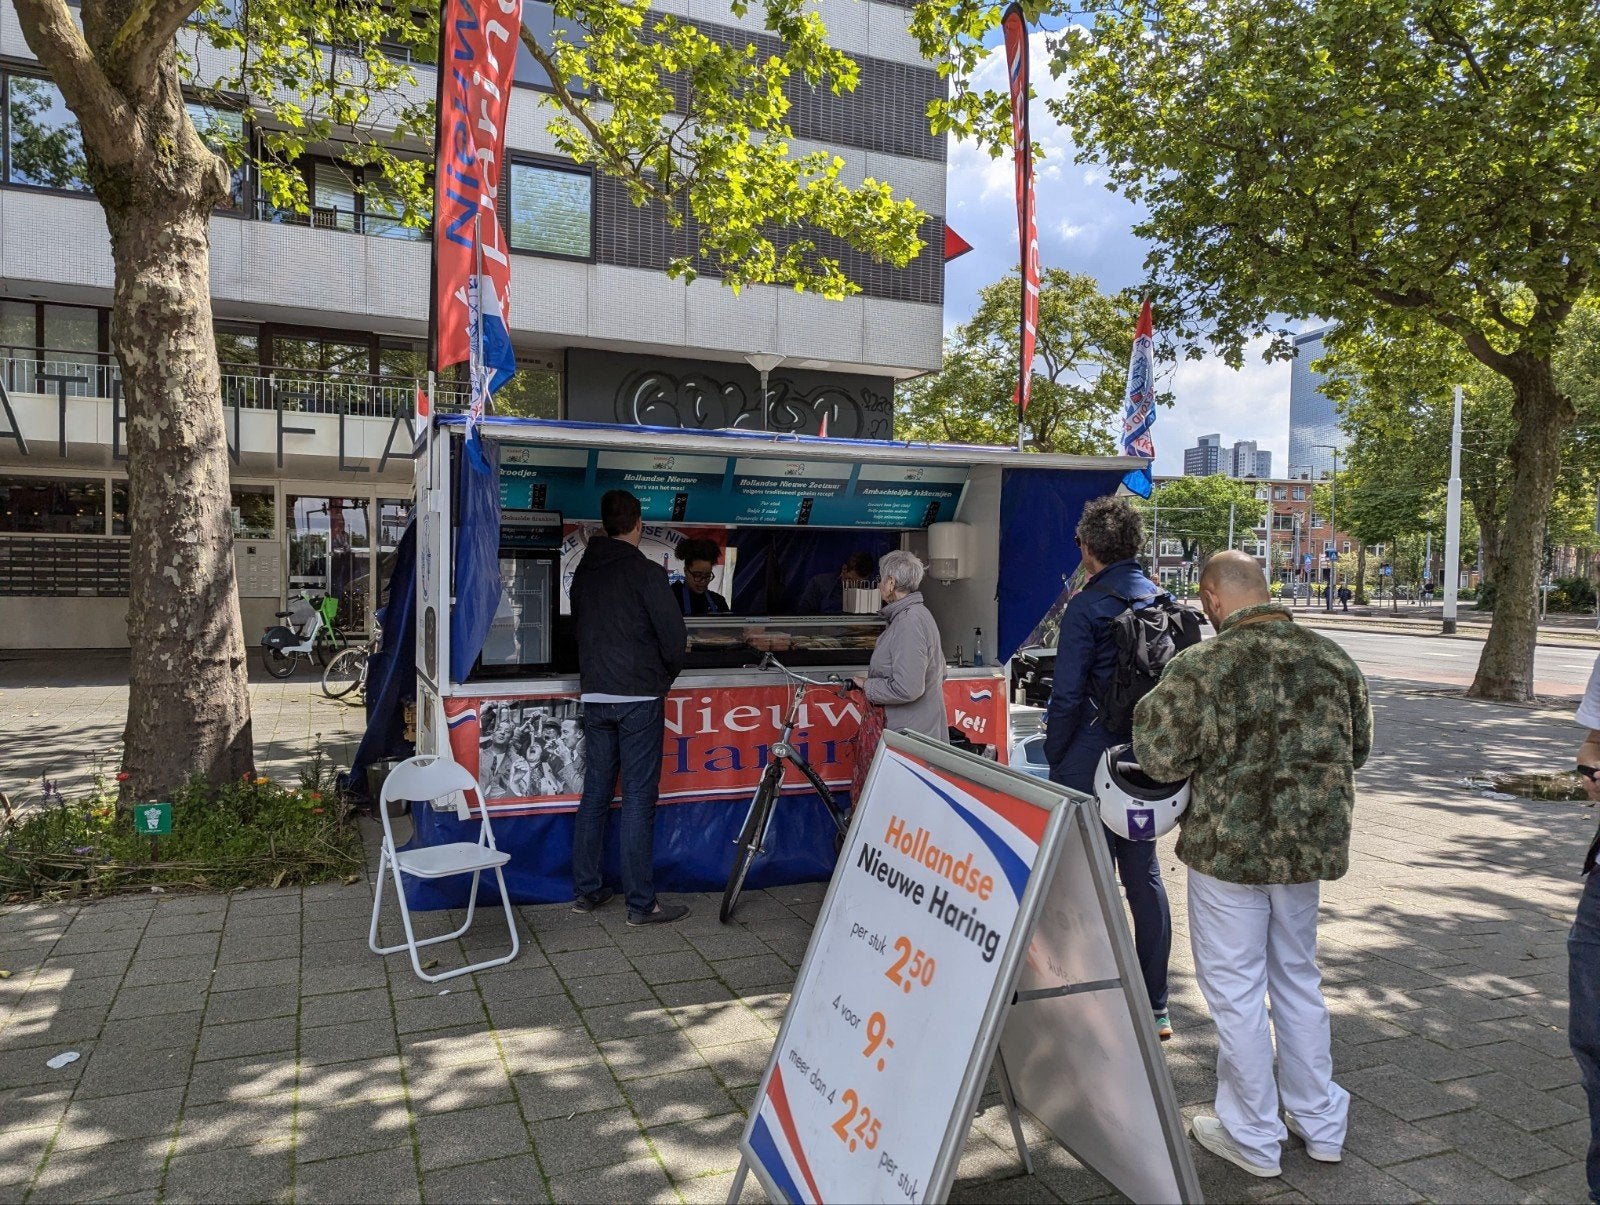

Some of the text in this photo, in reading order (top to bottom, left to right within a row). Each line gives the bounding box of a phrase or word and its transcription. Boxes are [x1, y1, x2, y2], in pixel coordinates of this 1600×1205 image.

[473, 0, 517, 267] Harin
[624, 474, 698, 484] Hollandse Nieuwe
[740, 479, 778, 487] Hollandse
[779, 480, 807, 488] Nieuwe
[862, 488, 953, 498] Ambachtelijke lekkernijen
[884, 815, 994, 901] Hollandse
[856, 842, 1001, 963] Nieuwe Haring
[850, 922, 868, 940] per
[868, 933, 888, 955] stuk
[832, 995, 842, 1010] 4
[841, 1004, 862, 1029] voor
[788, 1049, 811, 1077] meer
[809, 1068, 828, 1096] dan
[827, 1089, 838, 1105] 4
[877, 1151, 920, 1204] per stuk
